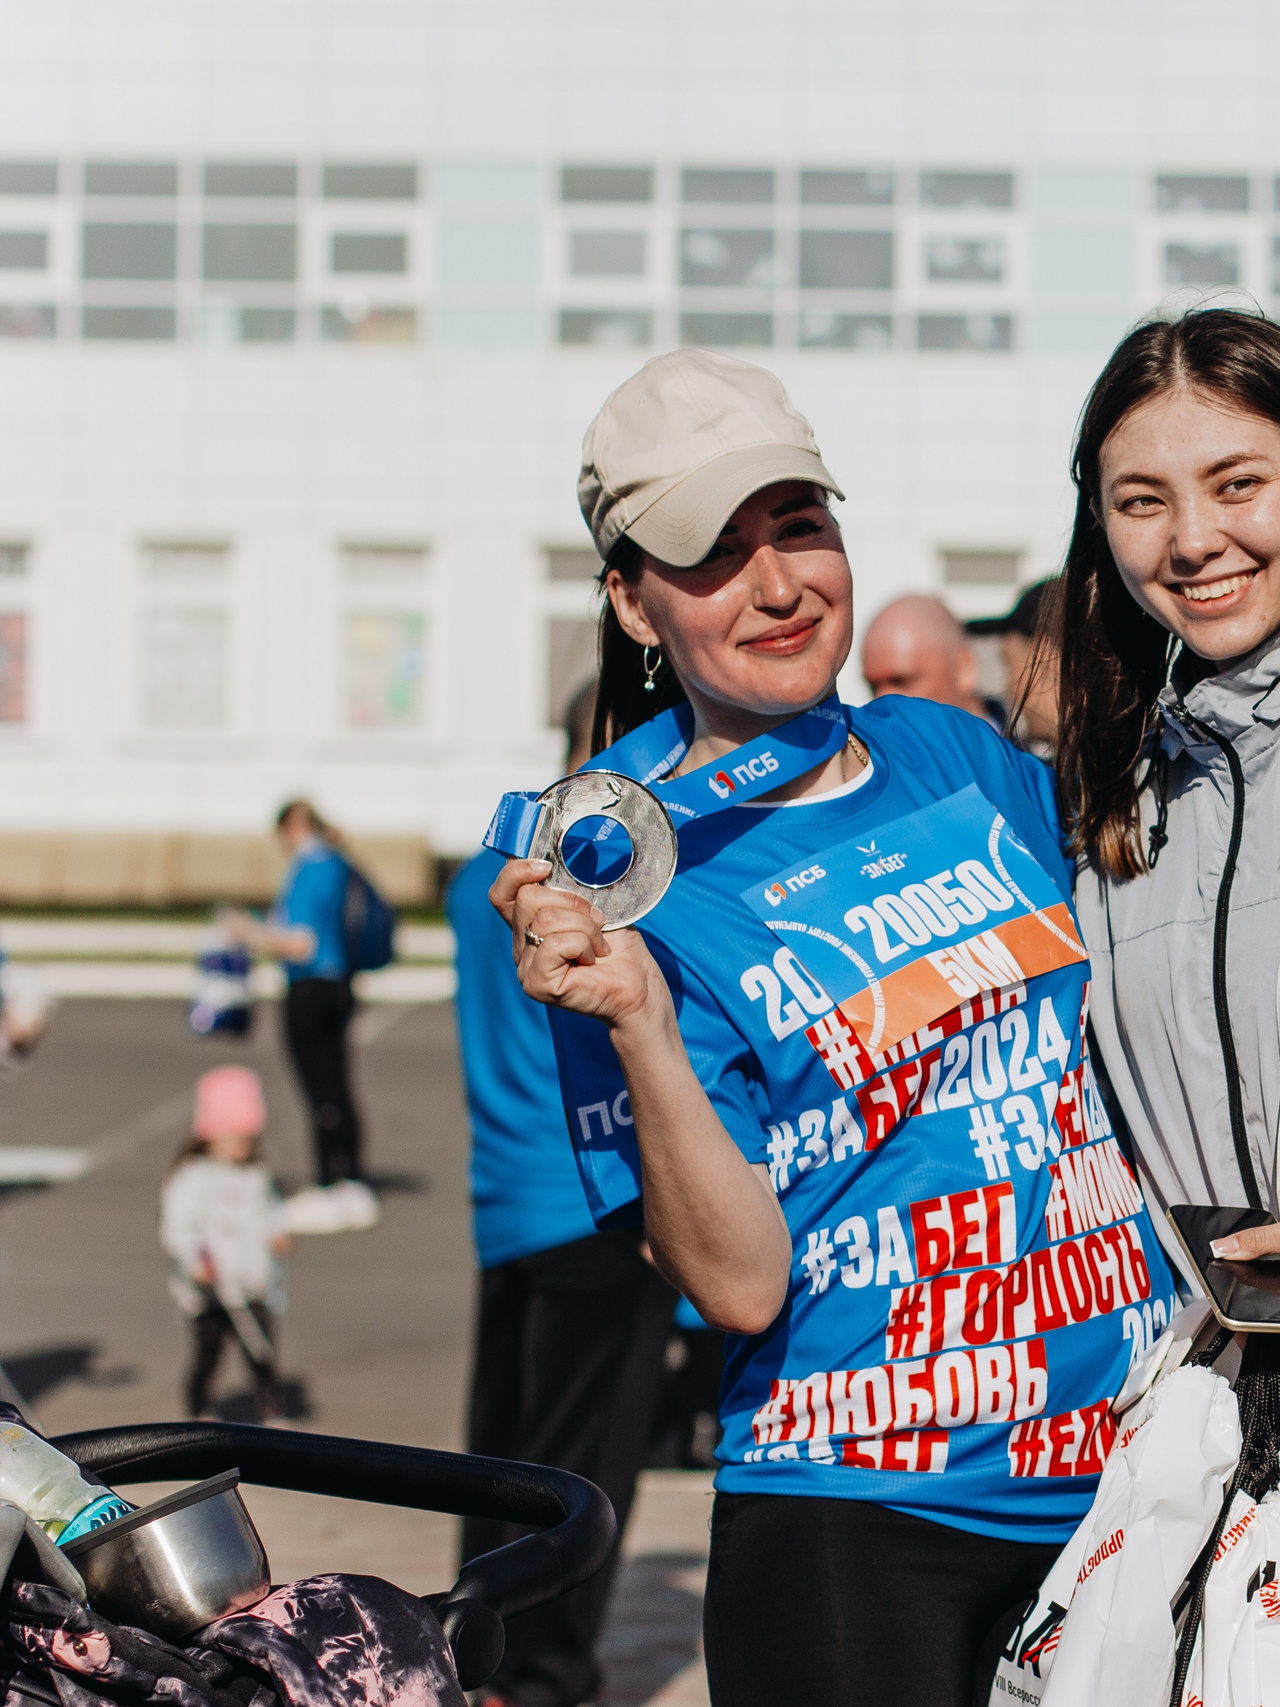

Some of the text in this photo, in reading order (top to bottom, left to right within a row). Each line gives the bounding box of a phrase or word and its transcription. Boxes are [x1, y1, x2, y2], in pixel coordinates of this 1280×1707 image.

[732, 751, 779, 786] ПСБ
[764, 920, 808, 933] #АДРЕНАЛ
[785, 864, 826, 893] ПСБ
[844, 859, 1014, 964] 20050
[806, 925, 843, 949] #ВОСТОРГ
[740, 946, 834, 1042] 20
[577, 1089, 634, 1141] ПС
[1045, 1138, 1143, 1241] #МОМЕ
[801, 1182, 1017, 1295] #ЗАБЕГ
[886, 1221, 1151, 1360] #ГОРДОСТЬ
[752, 1338, 1048, 1445] #ЛЮБОВЬ
